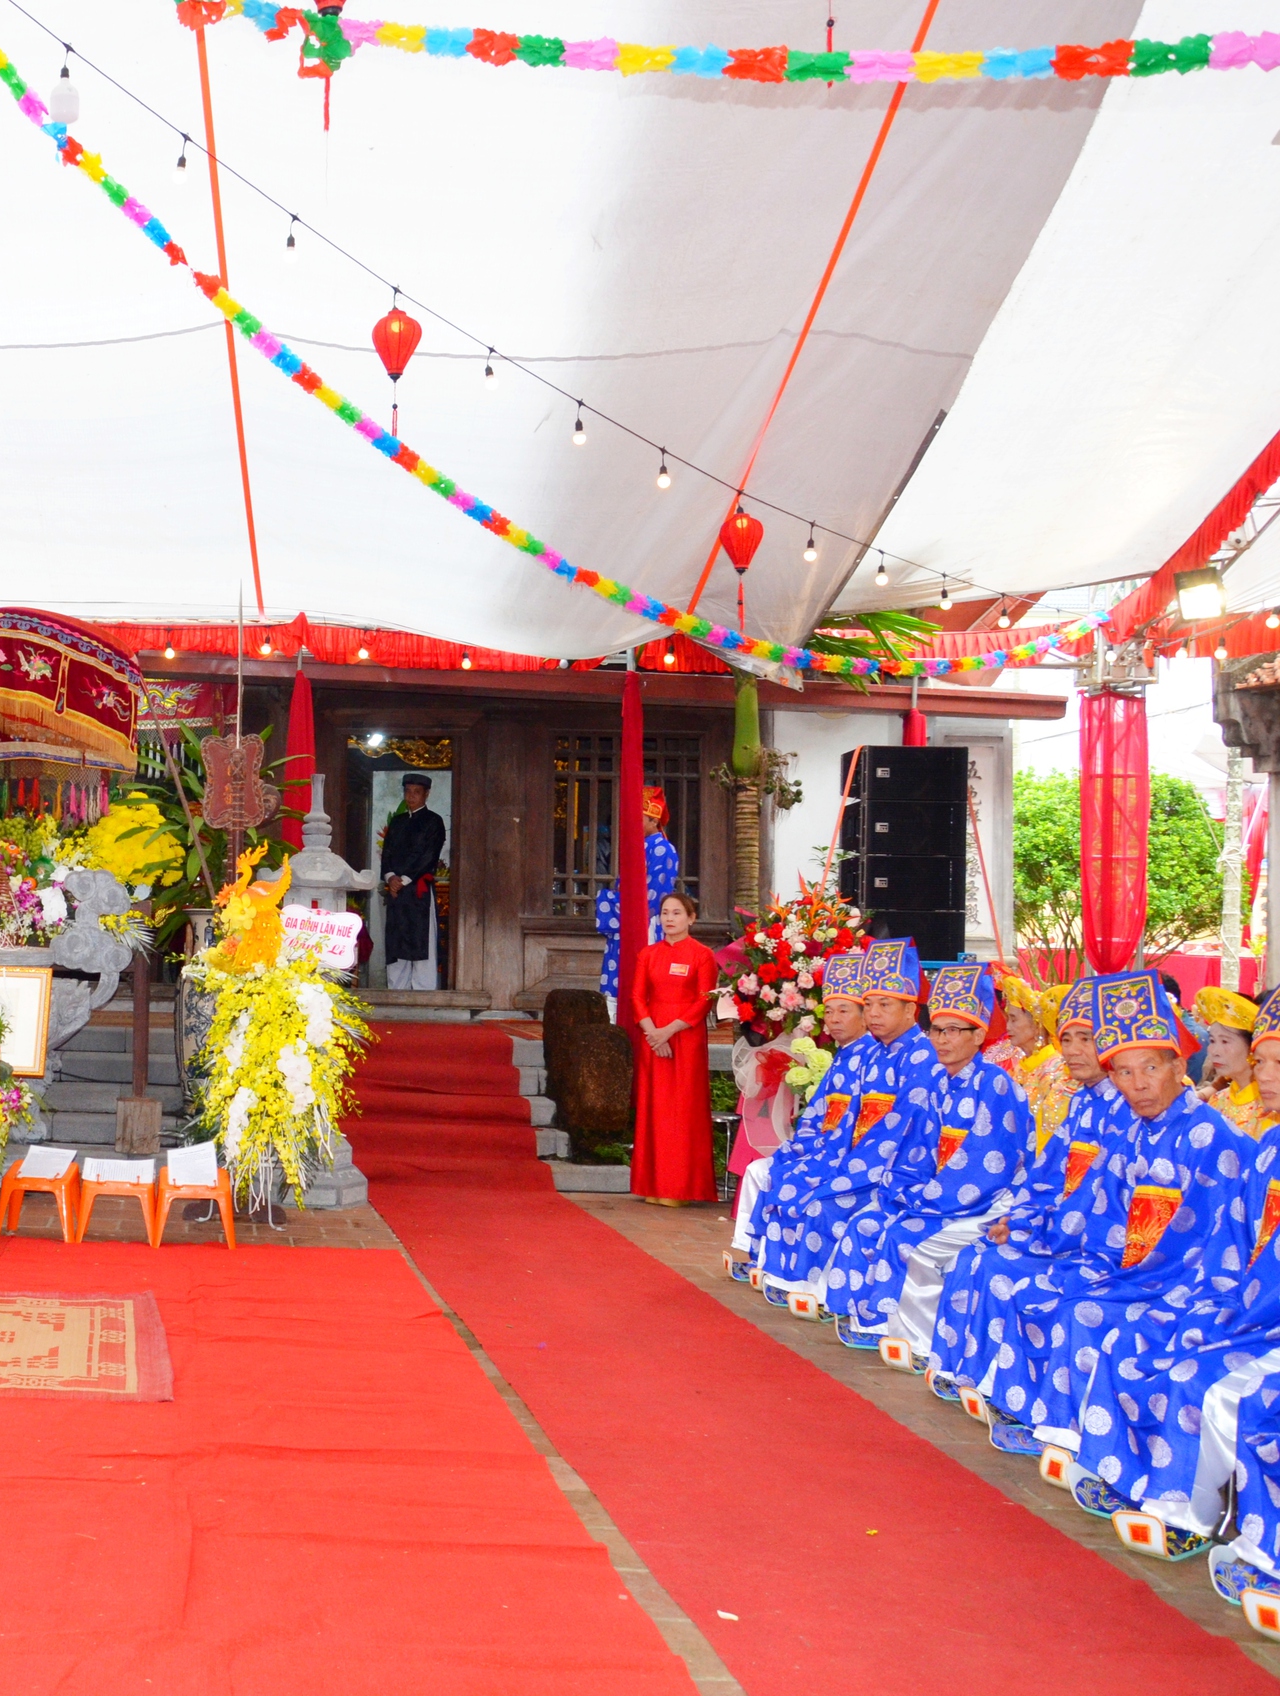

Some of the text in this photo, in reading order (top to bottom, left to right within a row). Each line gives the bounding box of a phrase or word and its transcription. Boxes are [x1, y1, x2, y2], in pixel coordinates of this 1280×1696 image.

[285, 917, 298, 929] GIA
[320, 921, 335, 935] LÂN
[336, 924, 354, 938] HUẾ
